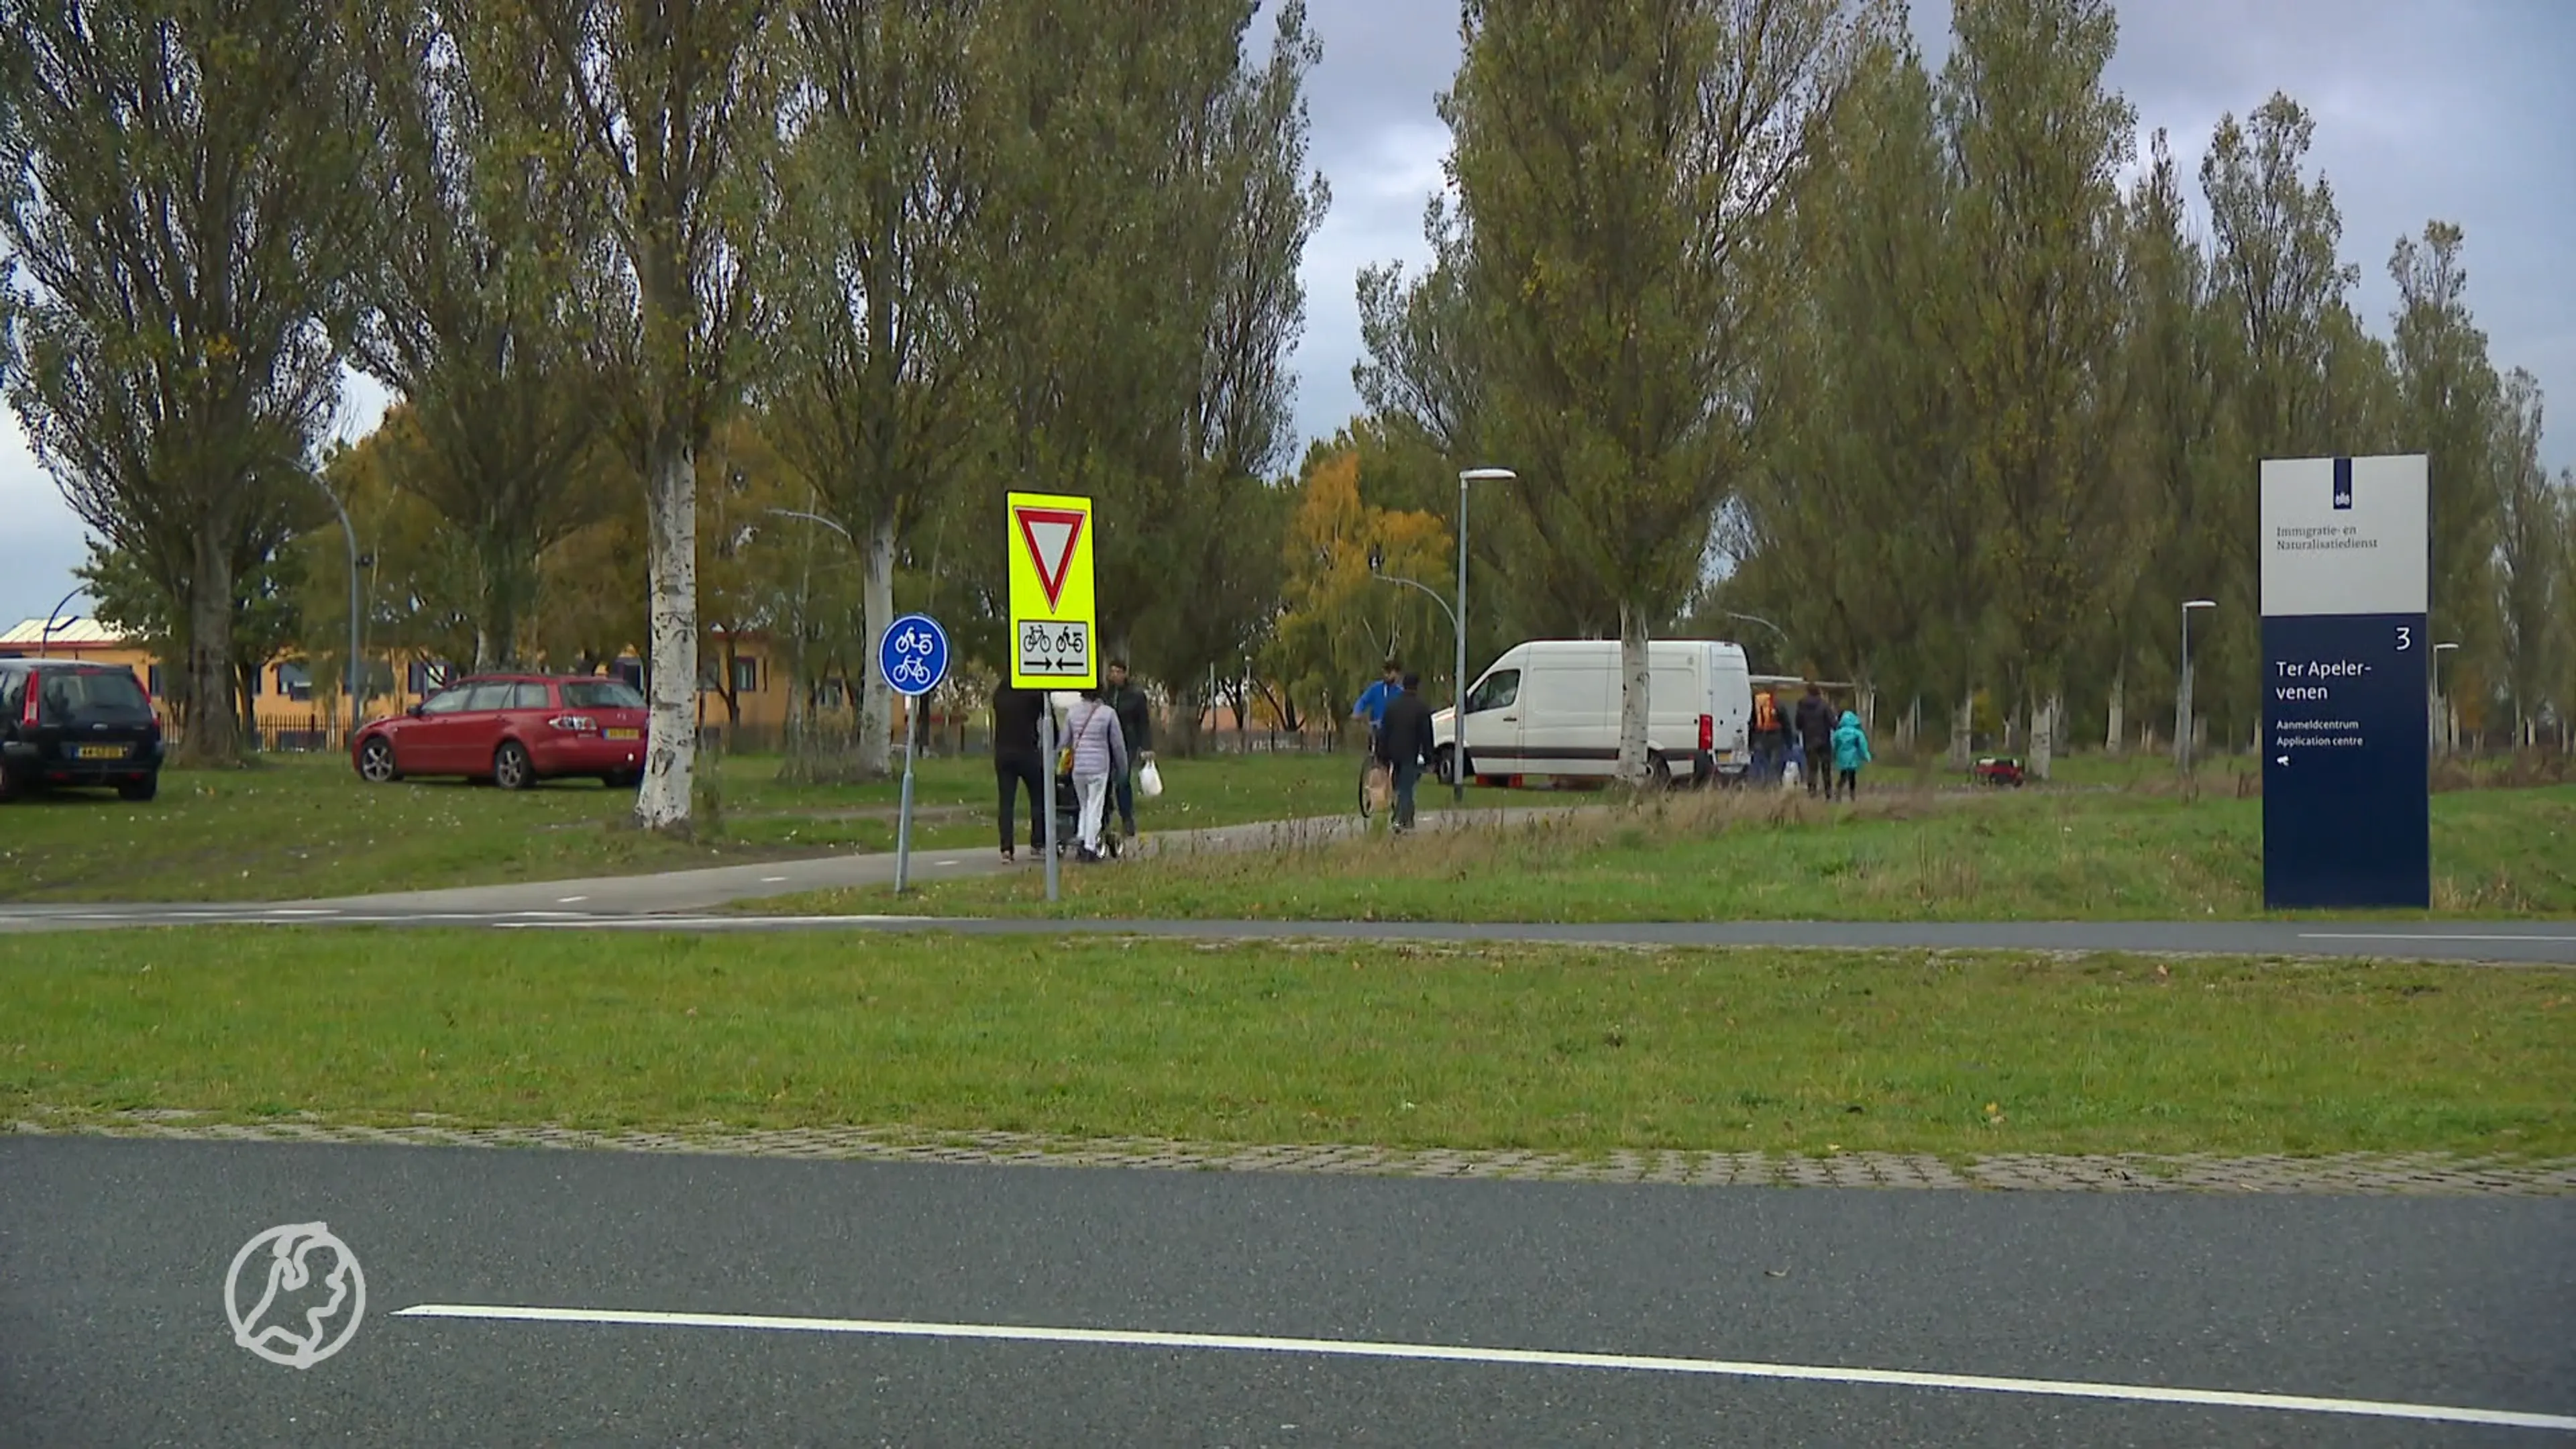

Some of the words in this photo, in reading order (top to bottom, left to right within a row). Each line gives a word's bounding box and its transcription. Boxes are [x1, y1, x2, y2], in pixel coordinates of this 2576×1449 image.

[2277, 525, 2341, 539] Immigratie-
[2343, 525, 2357, 536] en
[2277, 537, 2378, 550] Naturalisatiedienst
[2396, 627, 2411, 651] 3
[2276, 661, 2304, 677] Ter
[2308, 660, 2371, 679] Apeler-
[2276, 686, 2328, 700] venen
[2276, 719, 2359, 730] Aanmeldcentrum
[2276, 735, 2331, 748] Application
[2332, 736, 2363, 746] centre
